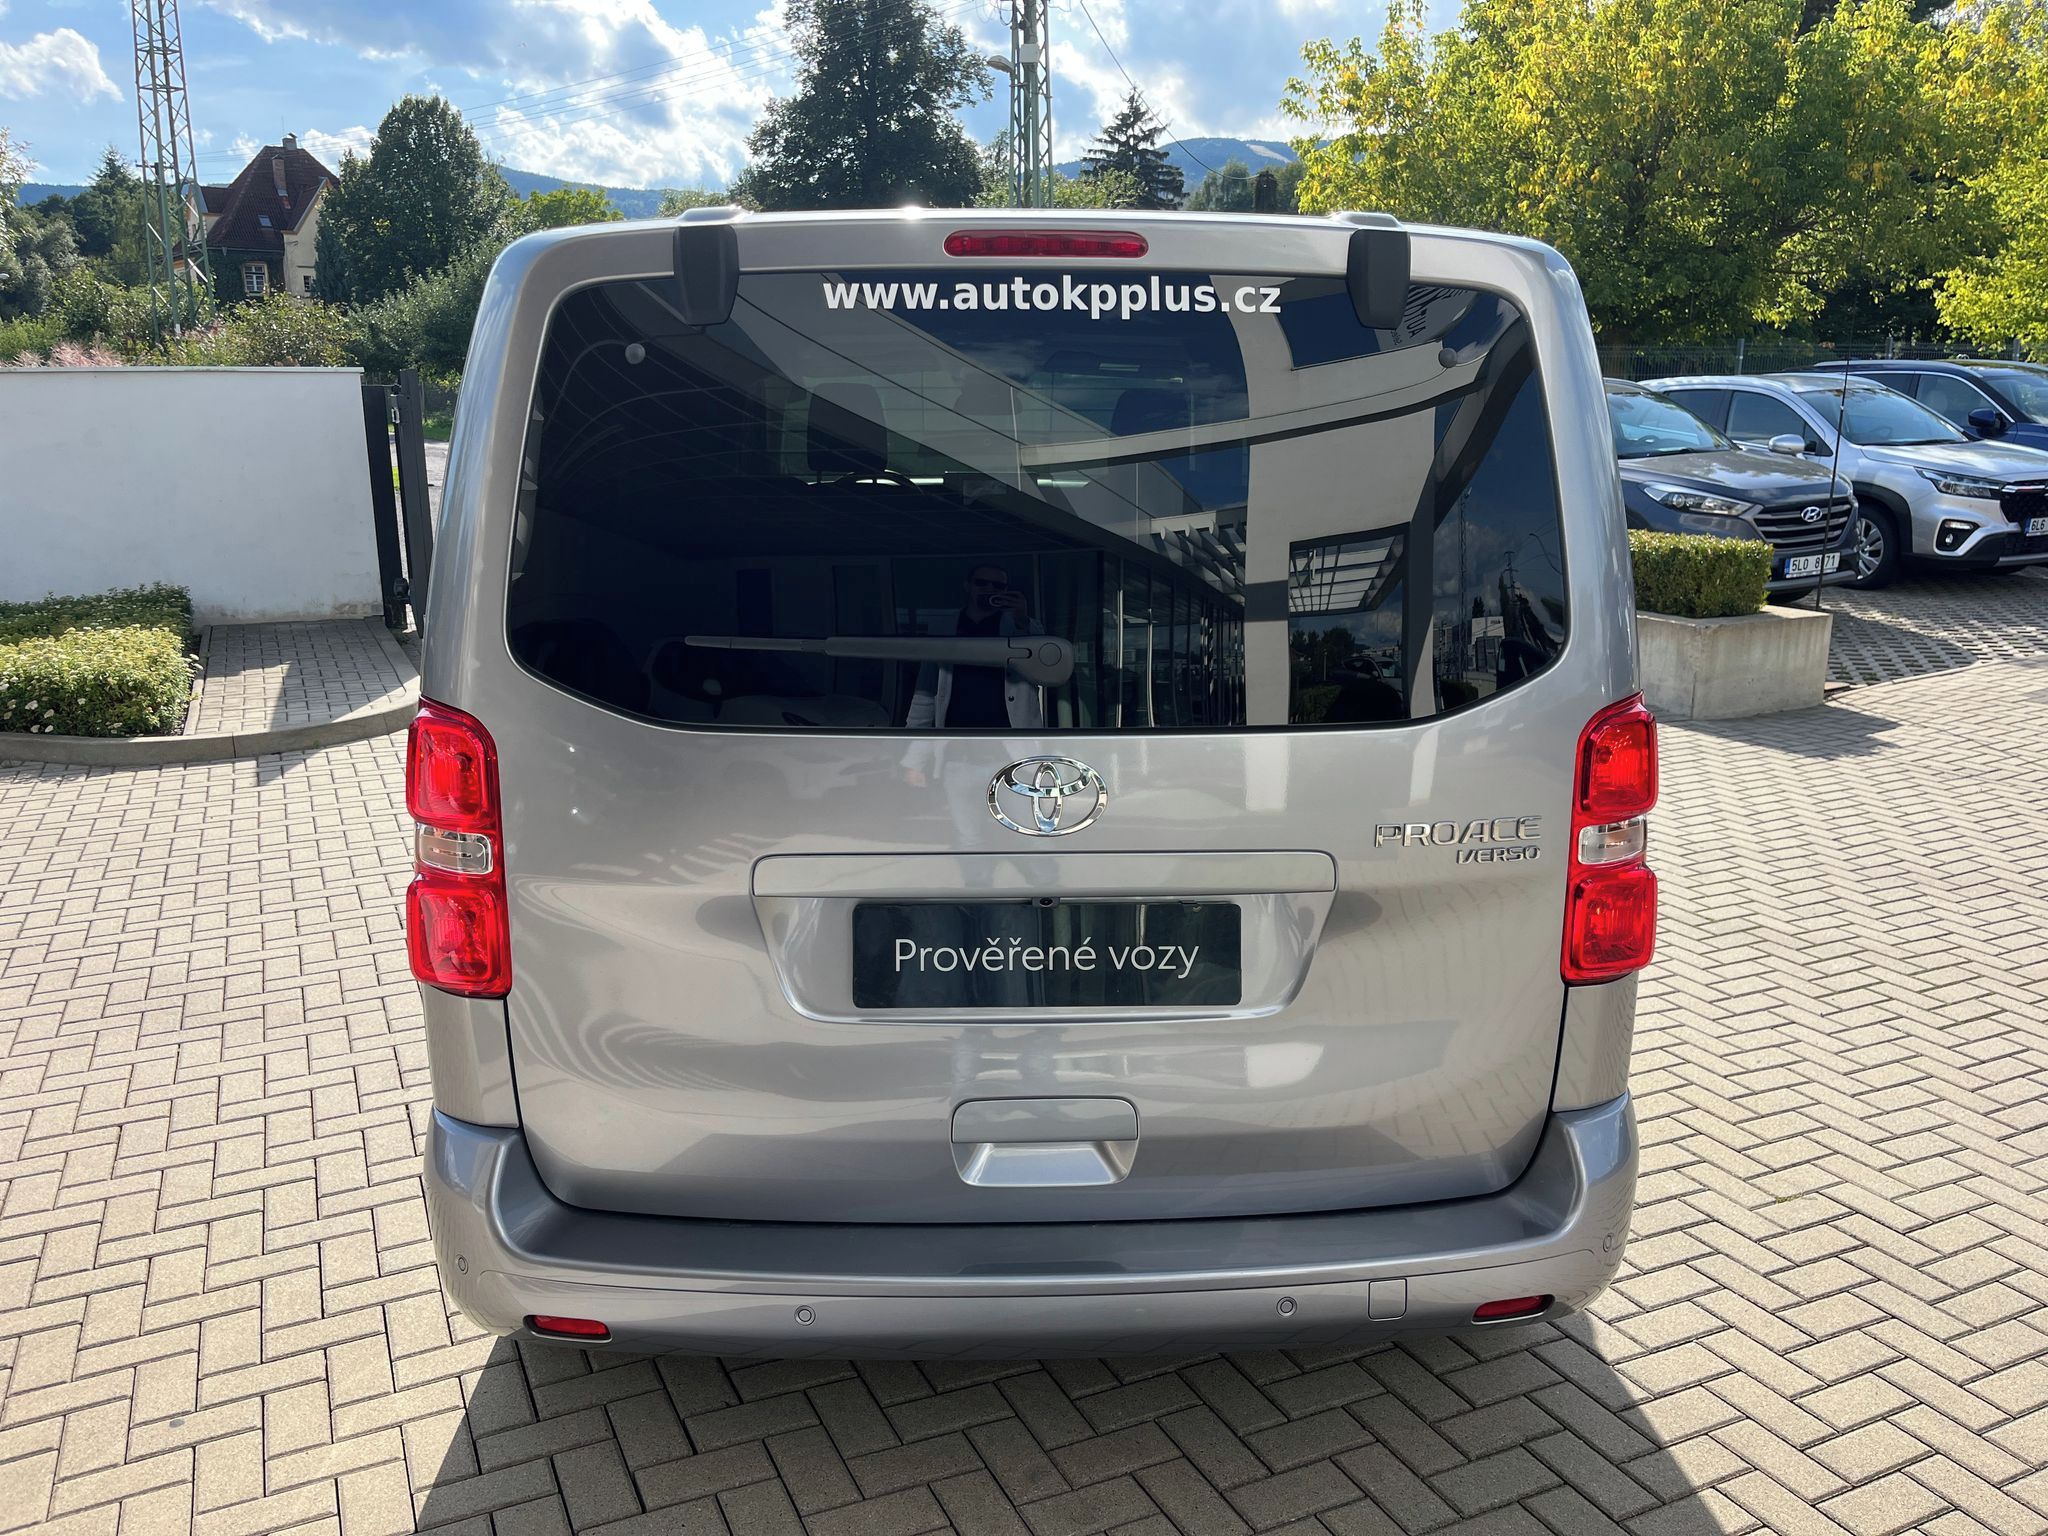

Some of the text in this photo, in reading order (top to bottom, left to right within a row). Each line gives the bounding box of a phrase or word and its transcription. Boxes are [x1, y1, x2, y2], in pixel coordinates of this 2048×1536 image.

[821, 274, 1282, 320] www.autokpplus.cz
[1815, 555, 1835, 568] 871
[1374, 815, 1542, 847] PROACE
[1456, 845, 1541, 864] VERSO
[894, 936, 1200, 979] Prověřené vozy
